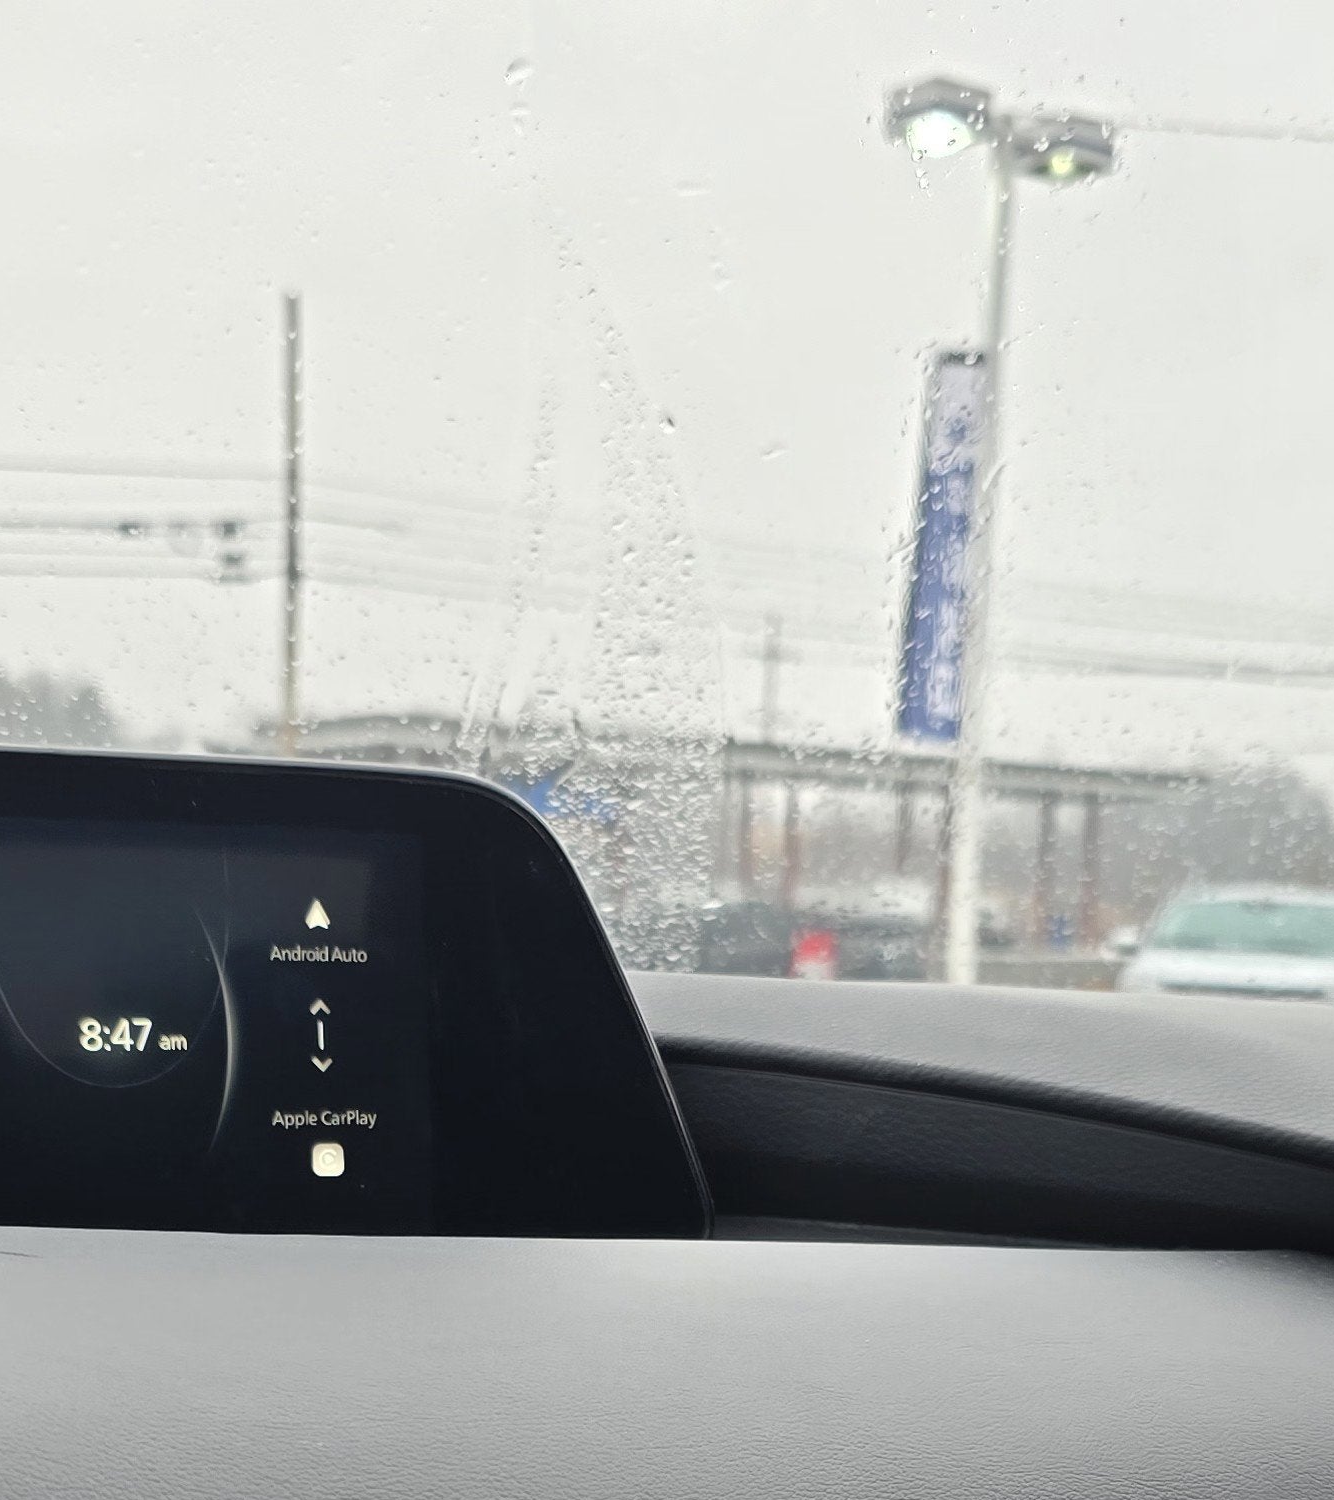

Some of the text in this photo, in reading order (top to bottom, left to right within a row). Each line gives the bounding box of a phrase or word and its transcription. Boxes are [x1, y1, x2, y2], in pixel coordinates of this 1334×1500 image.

[270, 944, 368, 963] Android Auto
[79, 1017, 188, 1052] 8:47 am
[272, 1109, 377, 1130] Apple CarPlay
